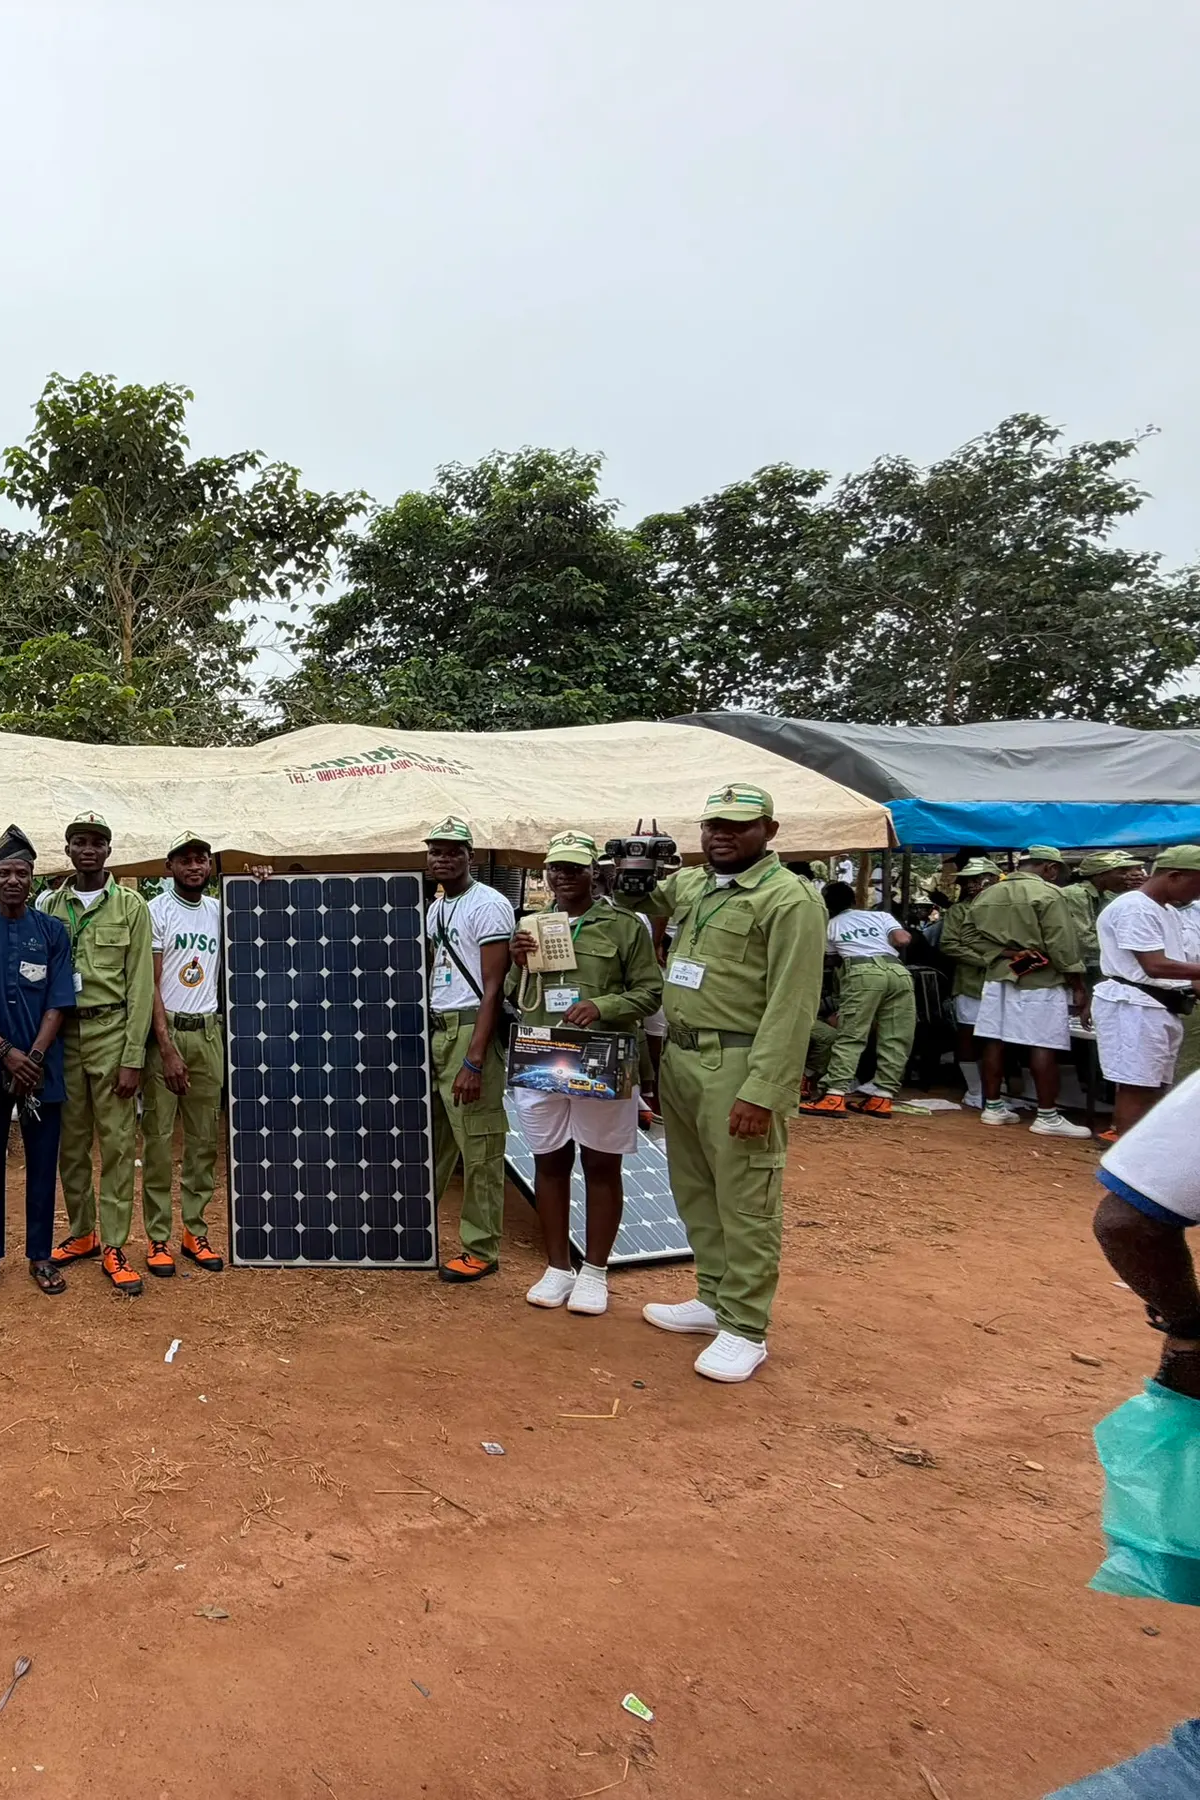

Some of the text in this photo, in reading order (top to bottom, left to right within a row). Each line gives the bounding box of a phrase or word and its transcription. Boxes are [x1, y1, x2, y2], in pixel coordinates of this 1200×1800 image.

[840, 927, 880, 942] NYSC
[174, 932, 217, 955] NYSC
[519, 1027, 535, 1037] TOP
